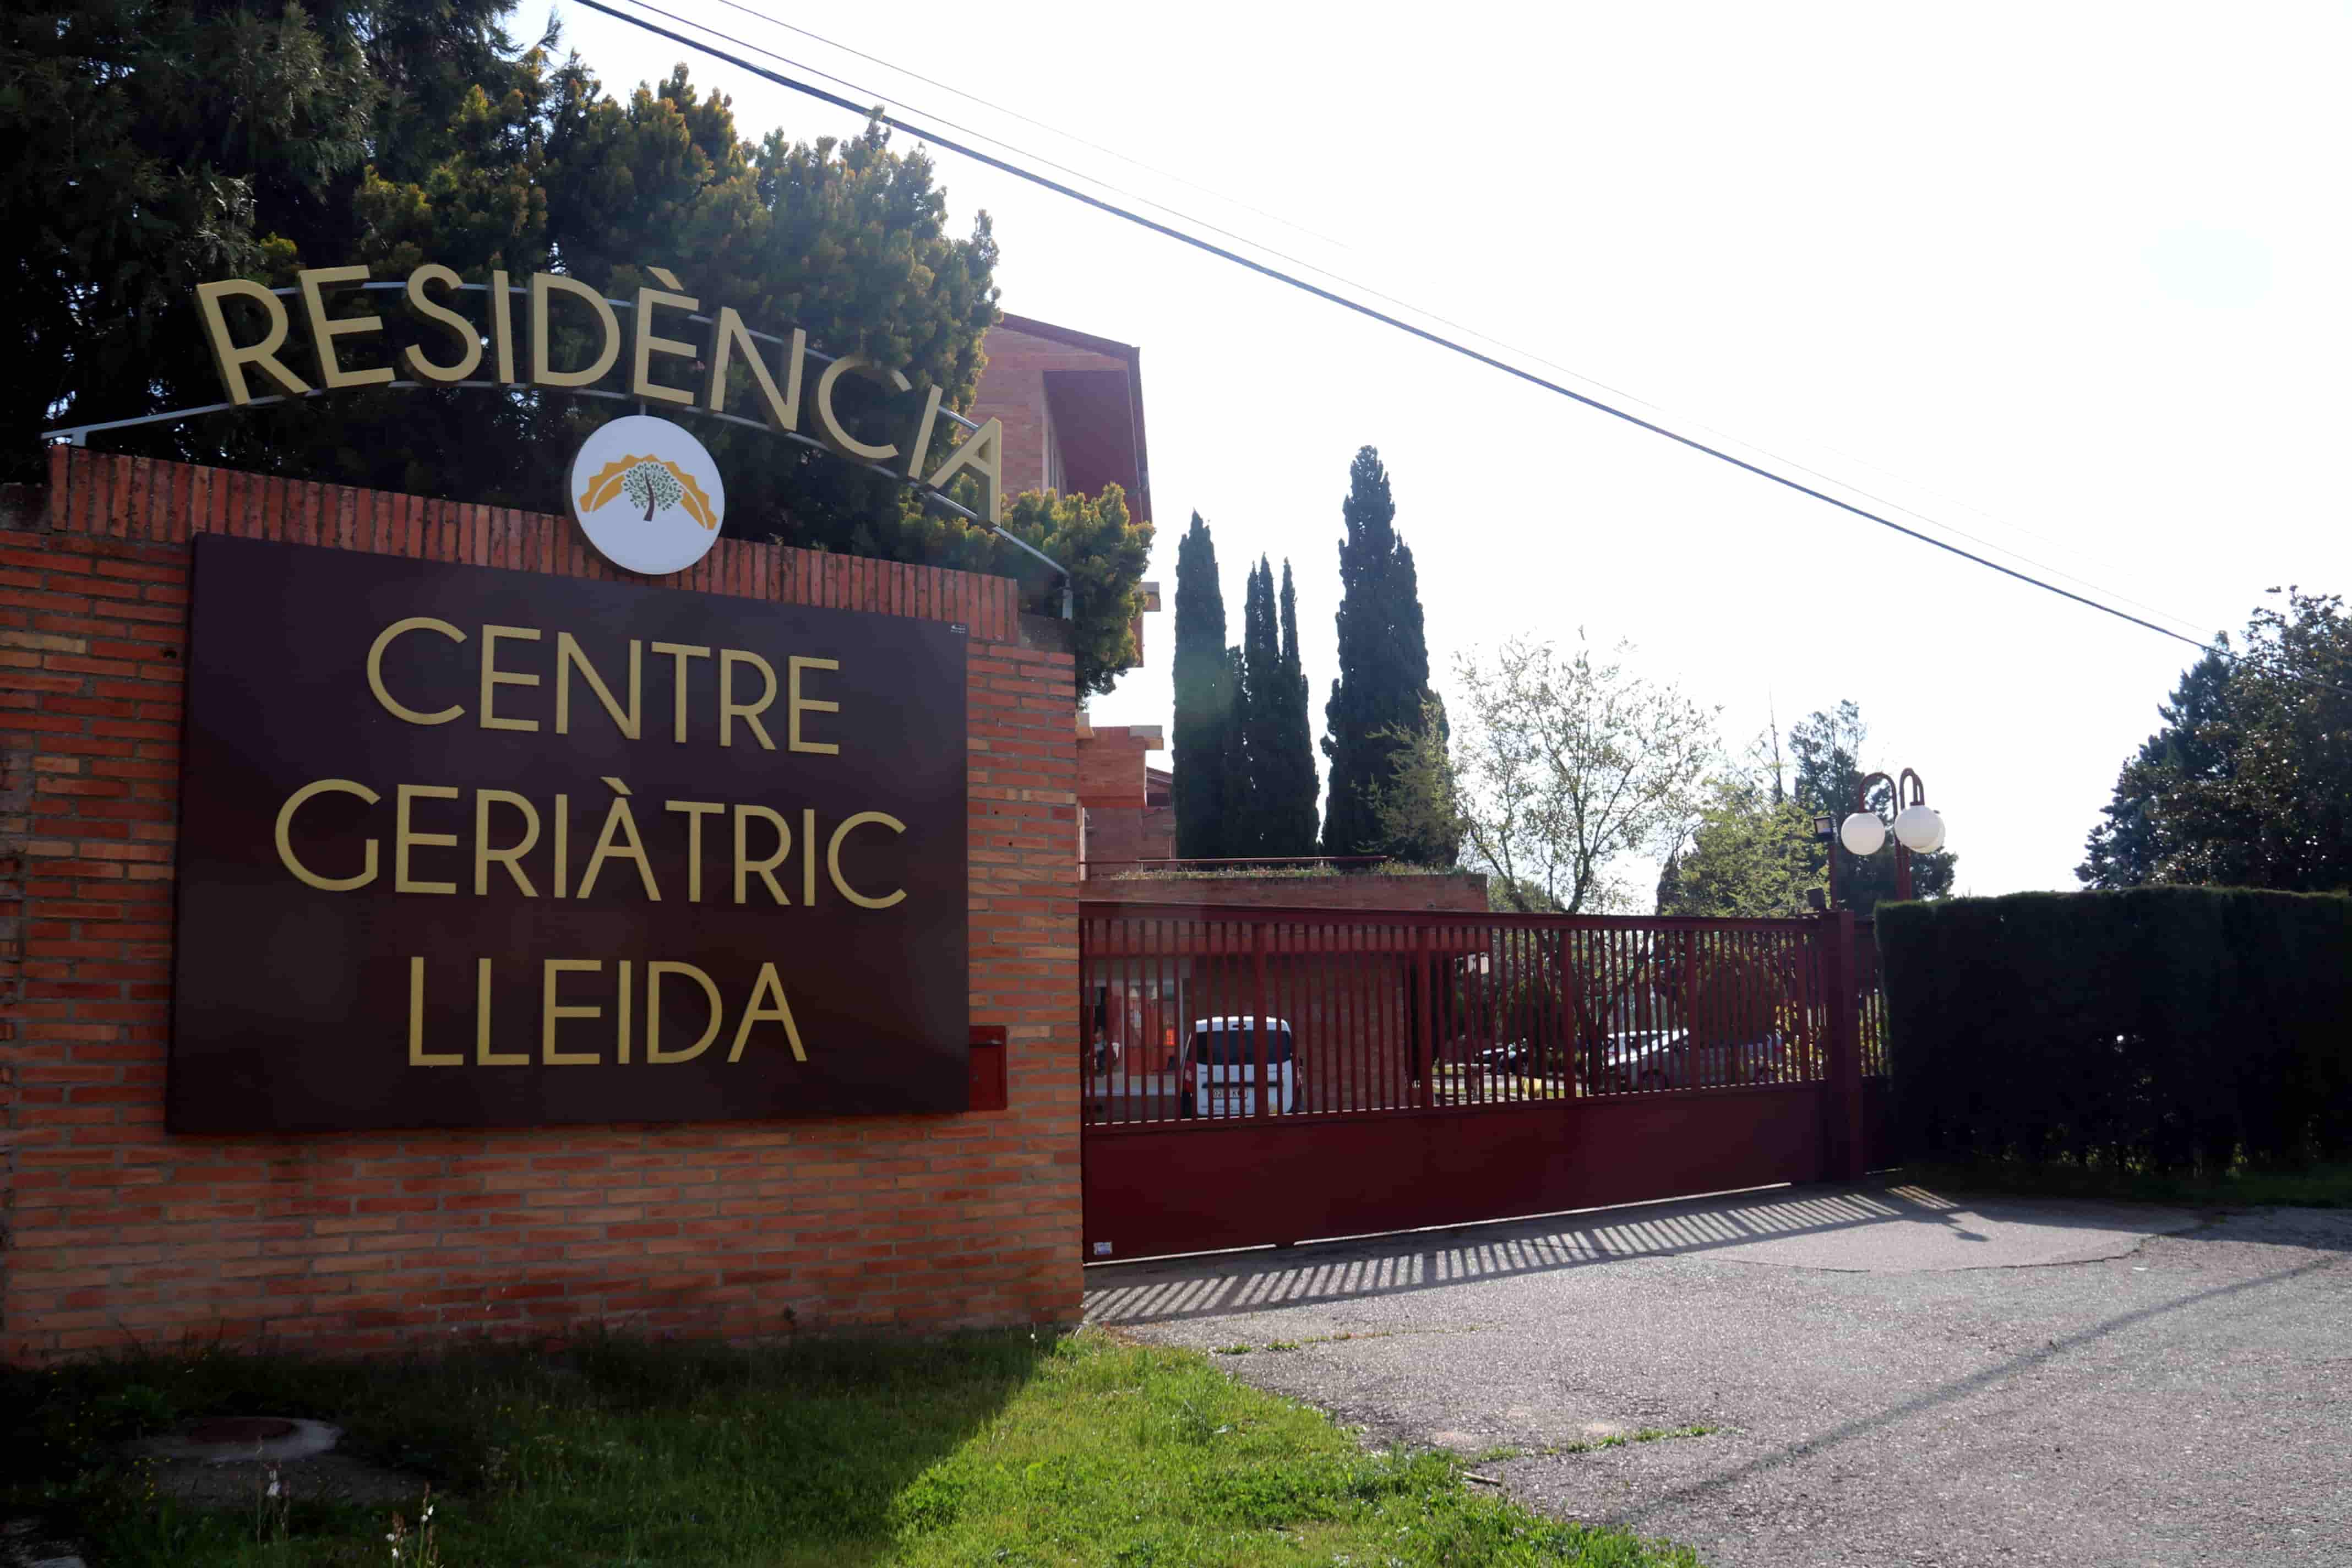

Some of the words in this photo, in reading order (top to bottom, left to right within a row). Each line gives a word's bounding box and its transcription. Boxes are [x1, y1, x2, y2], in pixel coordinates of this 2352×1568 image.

[197, 264, 1001, 526] RESIDÈNCIA
[367, 617, 839, 755] CENTRE
[275, 777, 907, 909] GERIÀTRIC
[409, 956, 807, 1066] LLEIDA
